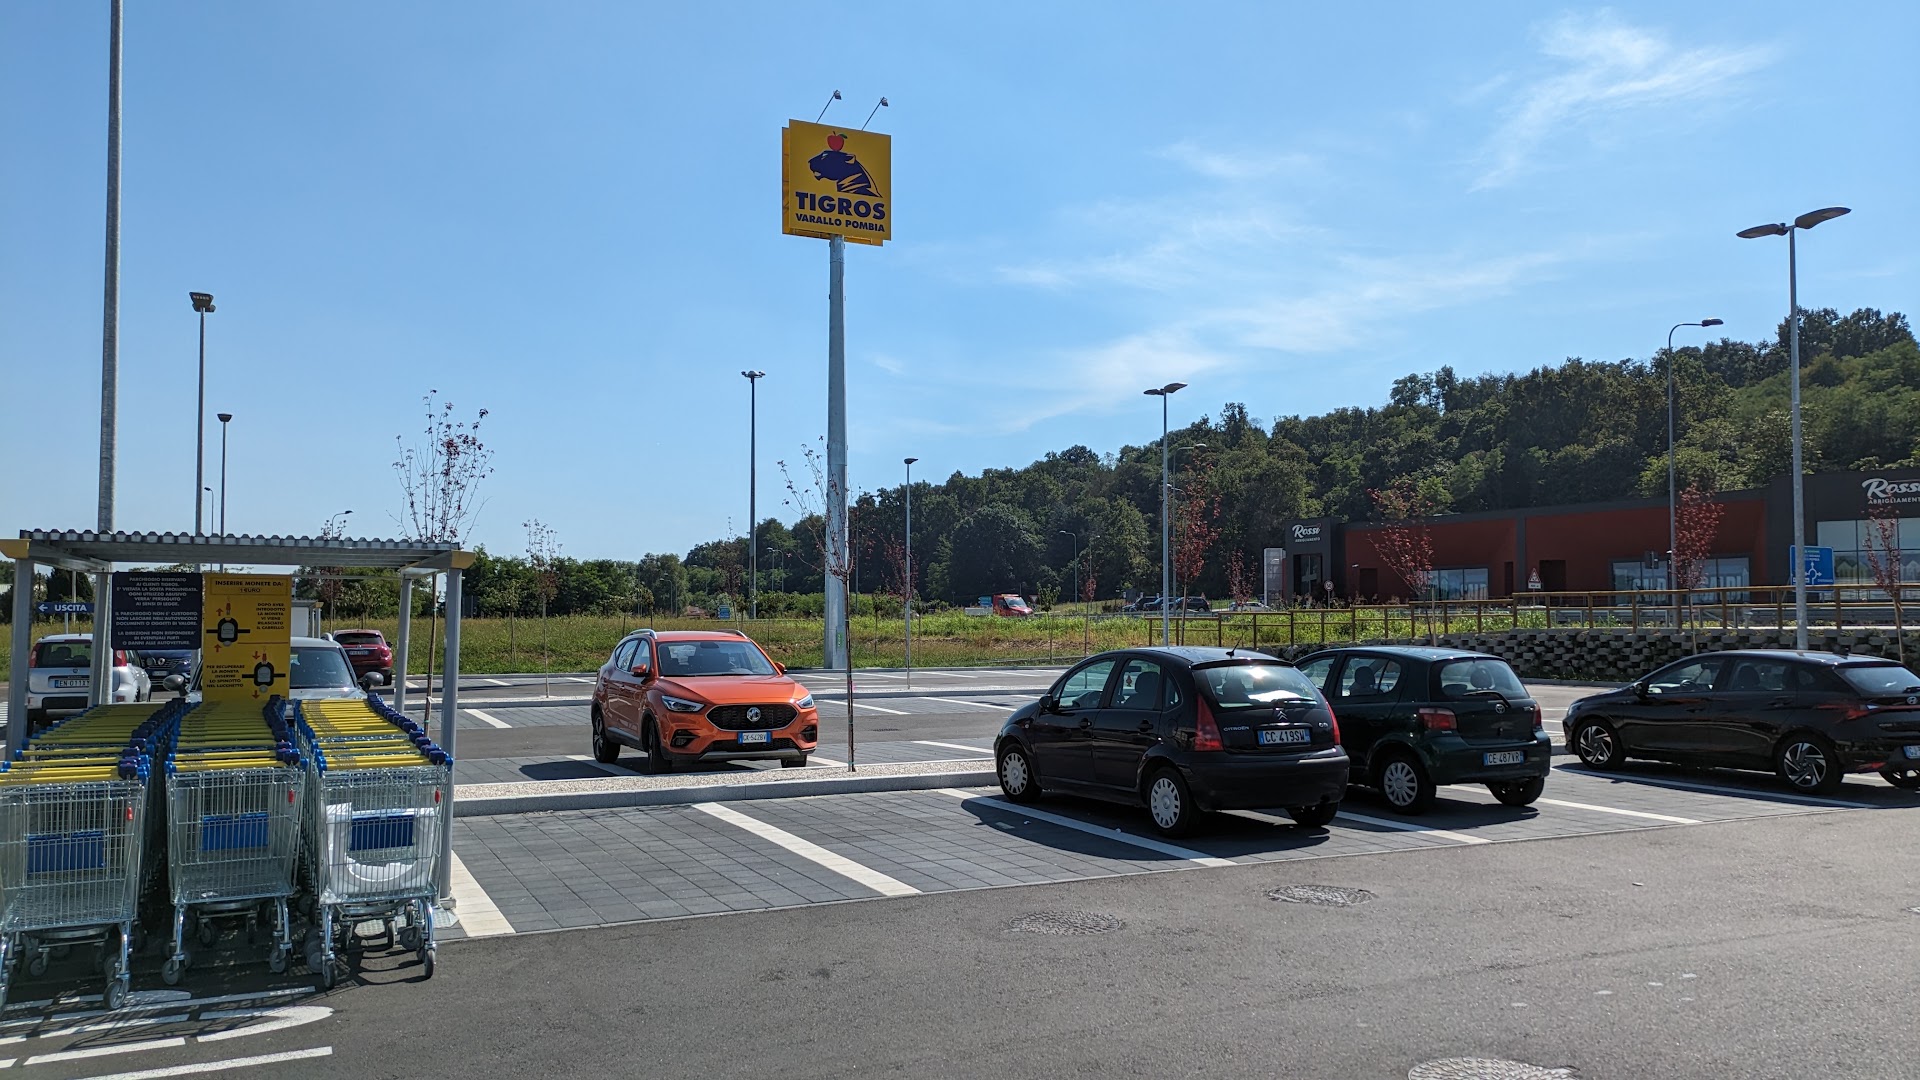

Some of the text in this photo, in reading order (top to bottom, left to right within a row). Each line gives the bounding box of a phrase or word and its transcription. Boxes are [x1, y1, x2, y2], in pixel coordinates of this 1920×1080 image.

[795, 192, 885, 220] TIGROS
[796, 213, 885, 232] VARALLO POMBIA
